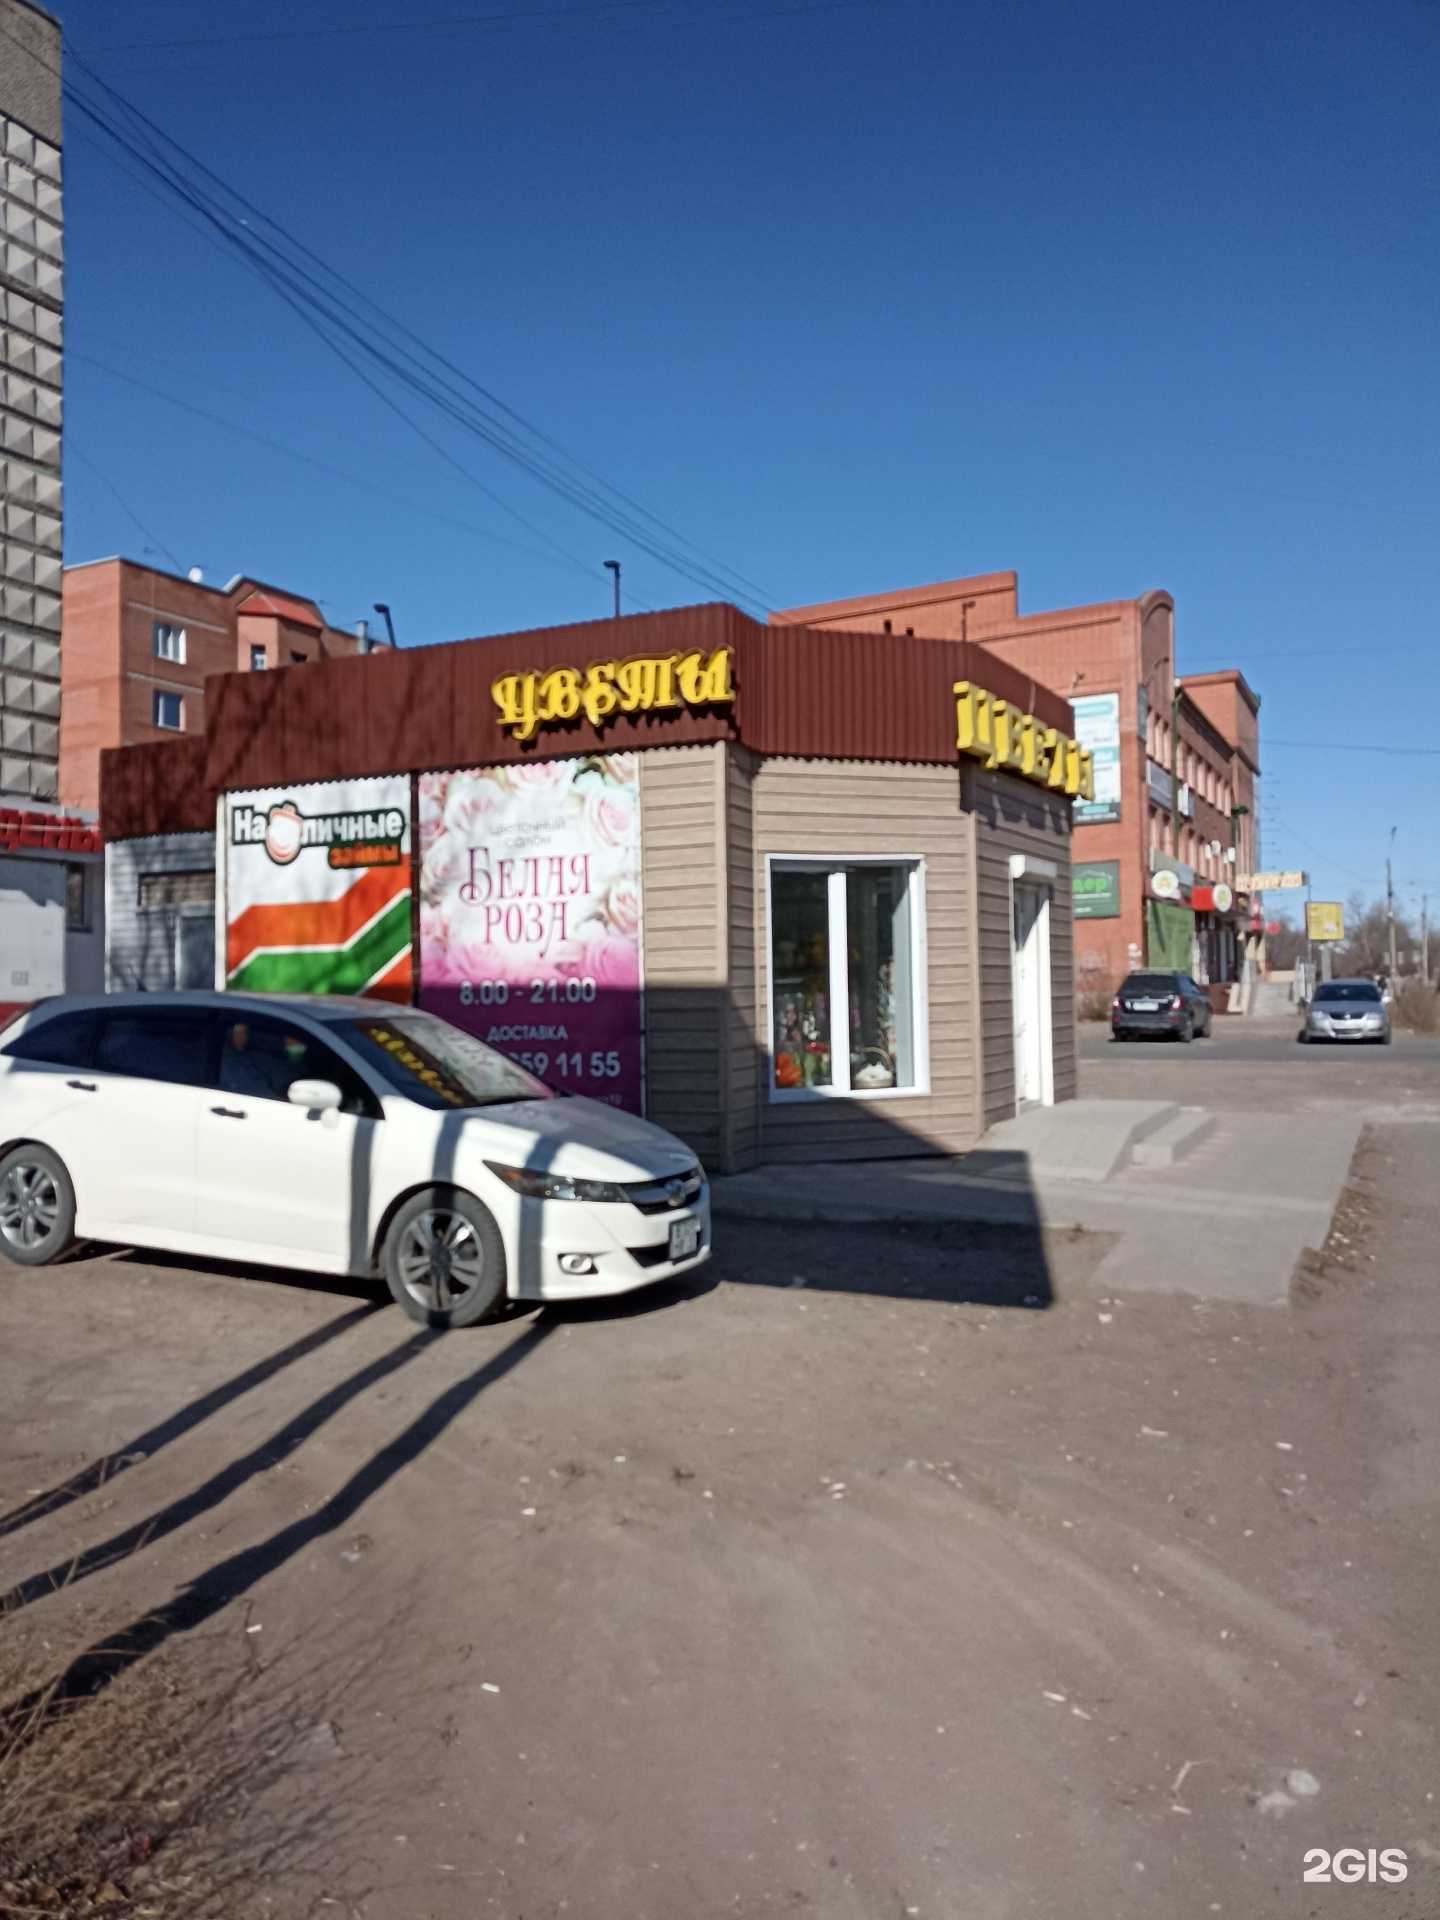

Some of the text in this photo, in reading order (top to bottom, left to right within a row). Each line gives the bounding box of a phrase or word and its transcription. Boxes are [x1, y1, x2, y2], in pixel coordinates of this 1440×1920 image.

[459, 980, 508, 1005] 8.00
[530, 976, 597, 1004] 21.00
[487, 1025, 569, 1042] ДОСТАВКА
[556, 1052, 583, 1077] 11
[590, 1051, 621, 1078] 55
